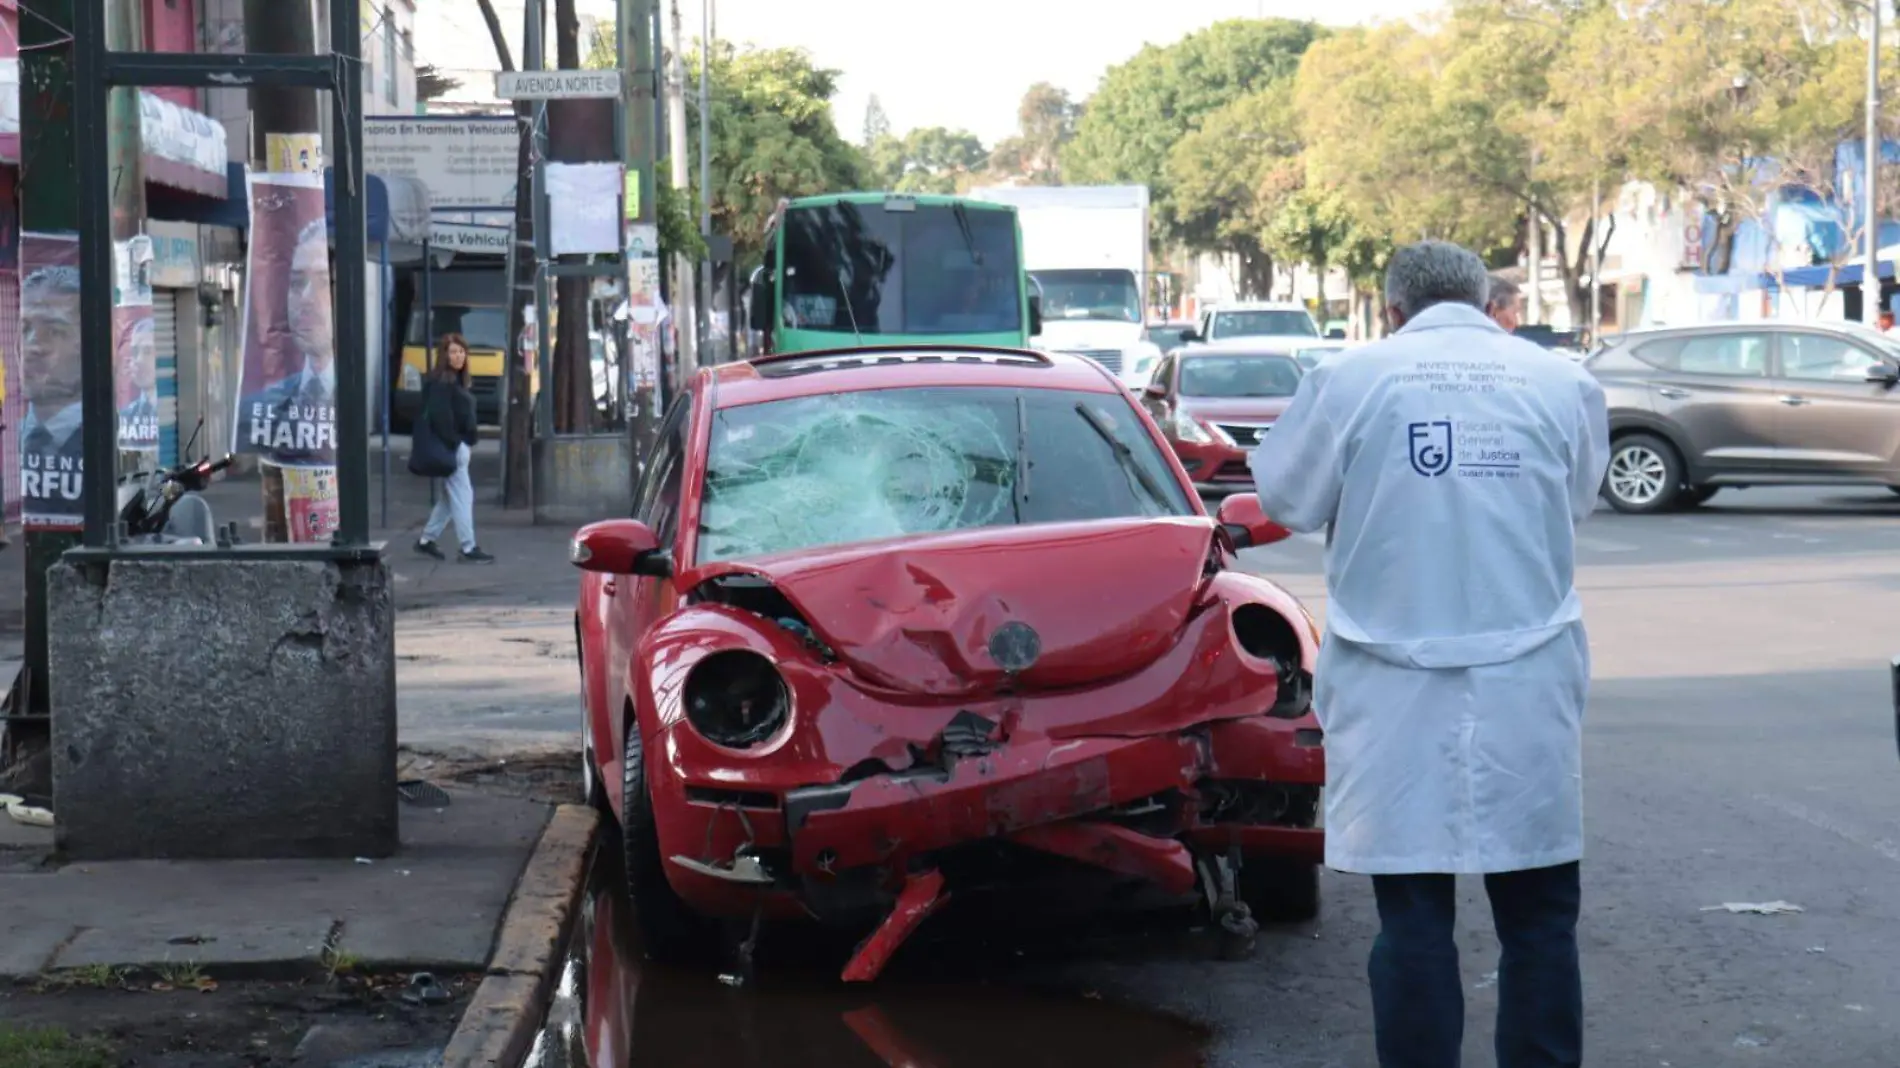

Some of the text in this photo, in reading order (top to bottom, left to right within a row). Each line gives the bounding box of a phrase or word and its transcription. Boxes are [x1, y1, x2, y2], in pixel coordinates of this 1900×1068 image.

[515, 76, 603, 93] AVENIDA NORTE
[400, 123, 415, 135] En
[1454, 373, 1463, 381] Y
[252, 402, 276, 419] EL
[1457, 435, 1504, 447] General
[1478, 449, 1520, 461] Justicia
